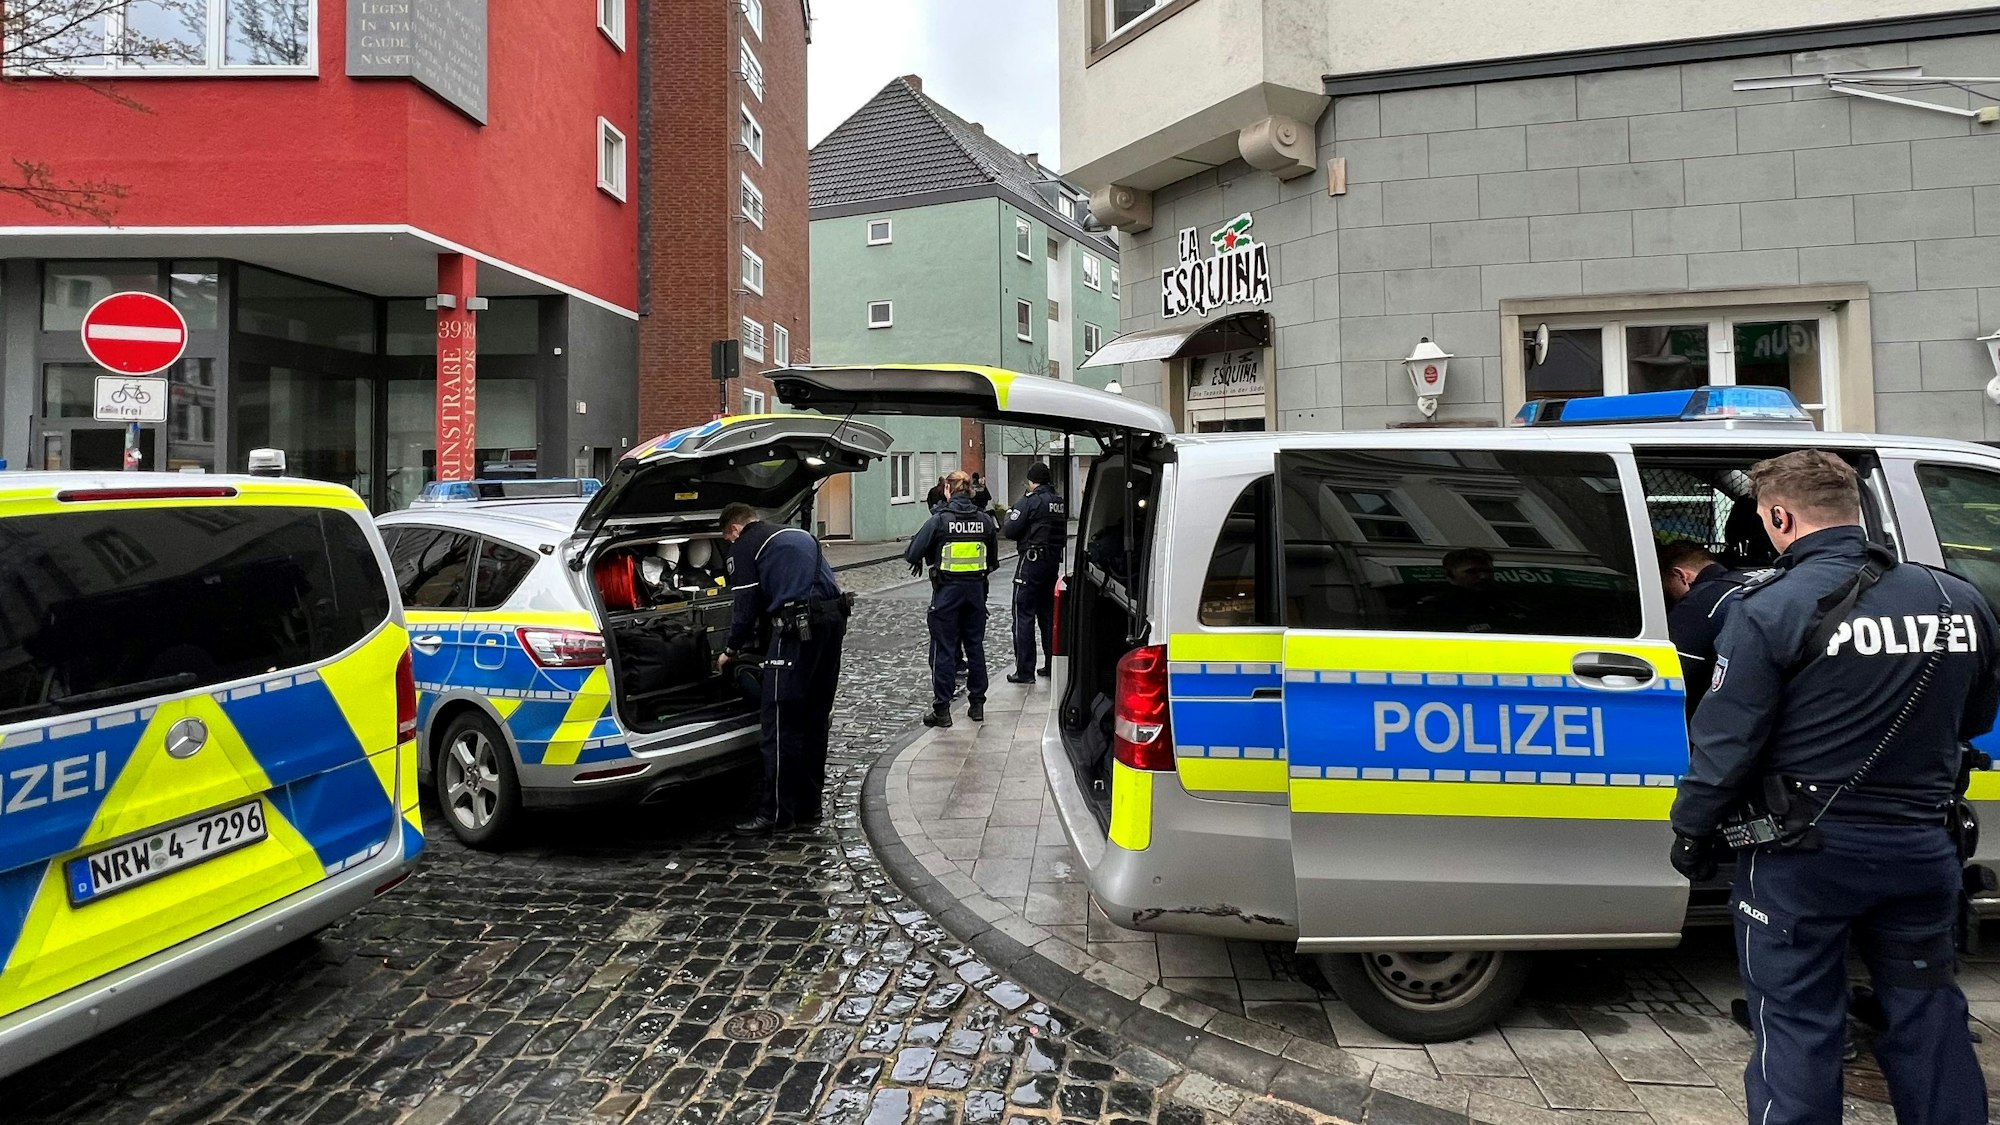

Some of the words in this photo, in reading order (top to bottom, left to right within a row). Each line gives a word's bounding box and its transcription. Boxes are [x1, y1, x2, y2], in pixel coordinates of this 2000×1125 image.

[362, 3, 408, 14] LEGEM
[361, 19, 377, 31] IN
[1180, 229, 1198, 263] LA
[1162, 245, 1270, 316] ESQUINA
[438, 321, 462, 339] 39
[1223, 352, 1231, 365] LA
[1211, 362, 1258, 386] ESQUINA
[120, 405, 142, 415] frei
[948, 521, 984, 534] POLIZEI
[1826, 614, 1978, 656] POLIZEI
[1373, 701, 1605, 757] POLIZEI
[78, 882, 88, 893] D
[90, 842, 151, 889] NRW
[1739, 900, 1769, 925] POLIZEI
